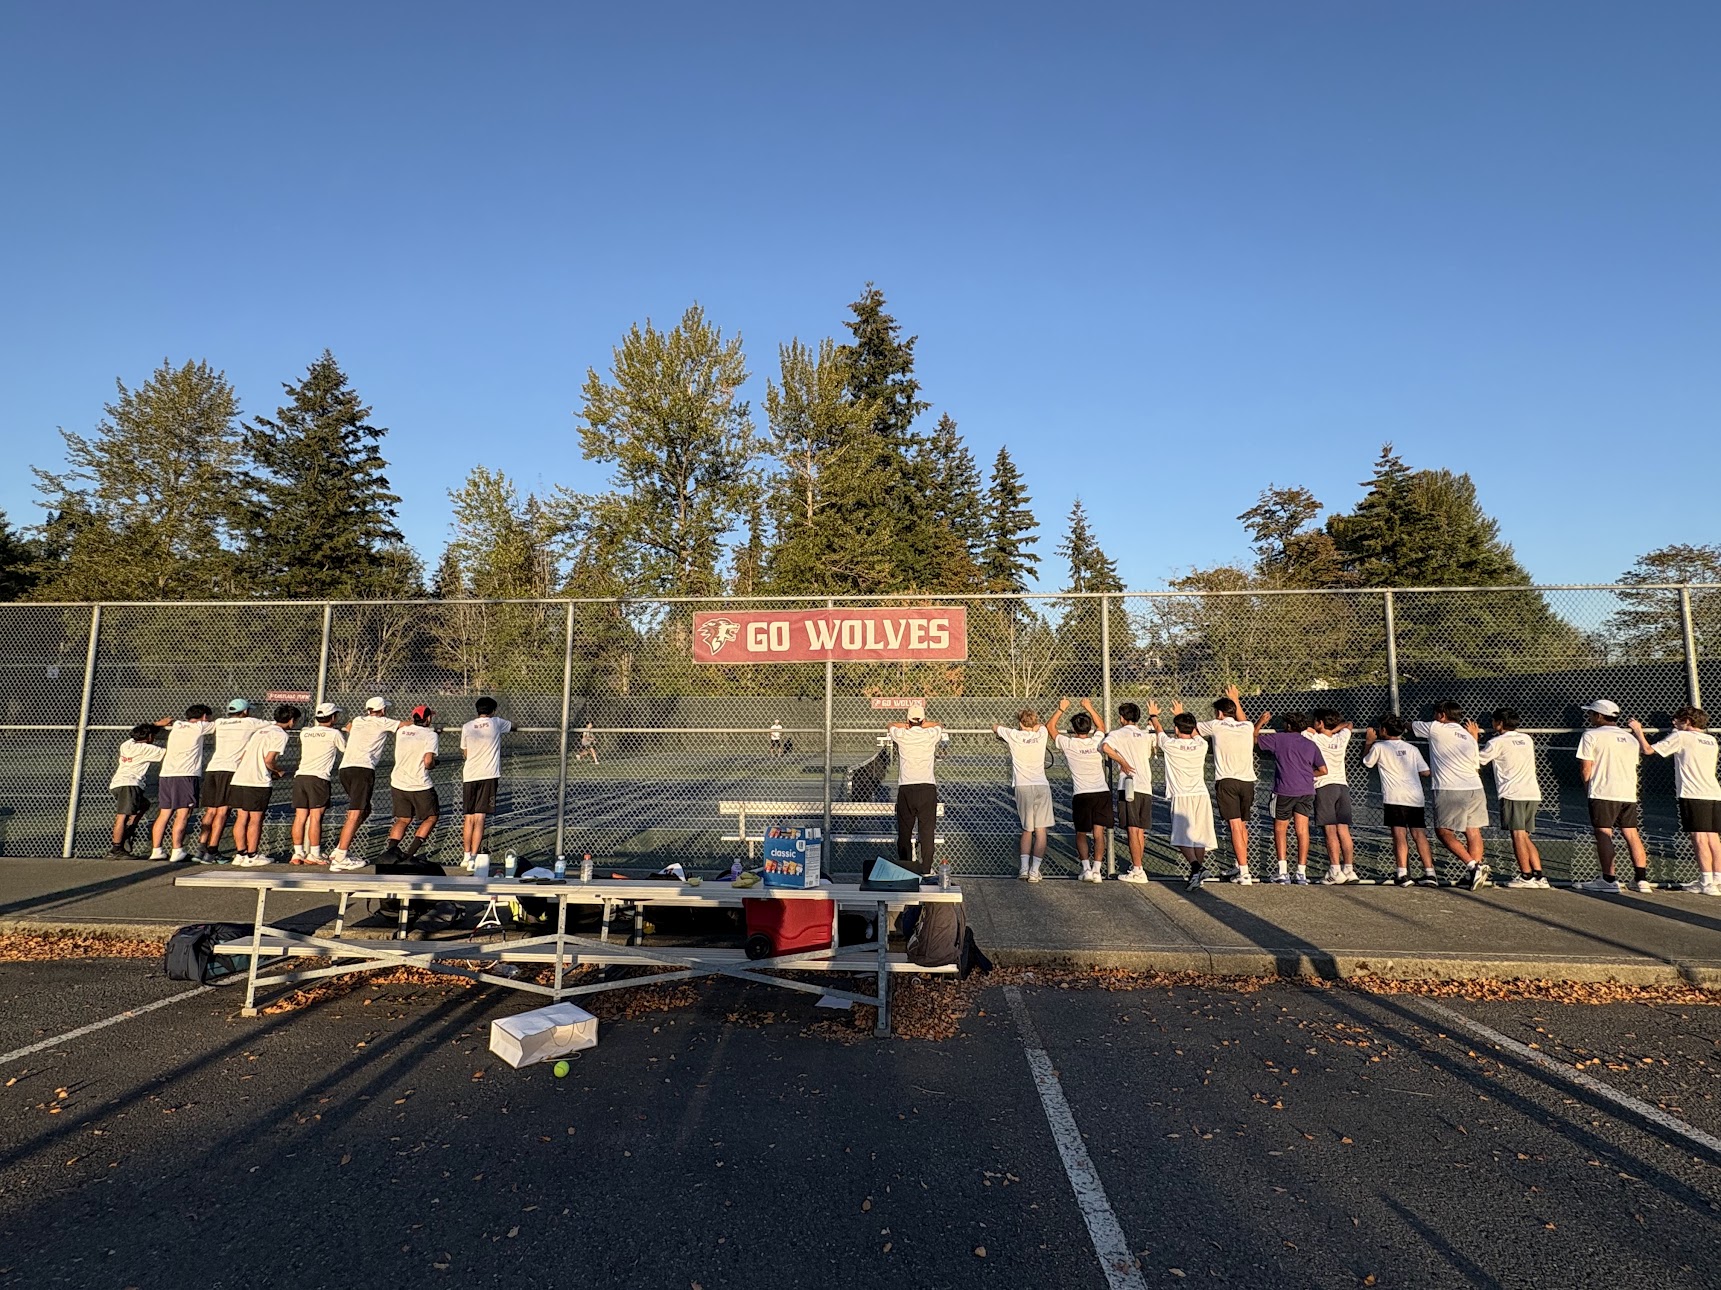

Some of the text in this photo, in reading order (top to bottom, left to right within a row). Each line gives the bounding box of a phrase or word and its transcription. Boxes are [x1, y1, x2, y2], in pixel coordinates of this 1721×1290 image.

[747, 618, 950, 652] GO WOLVES
[881, 699, 891, 707] GO
[770, 848, 797, 859] classic
